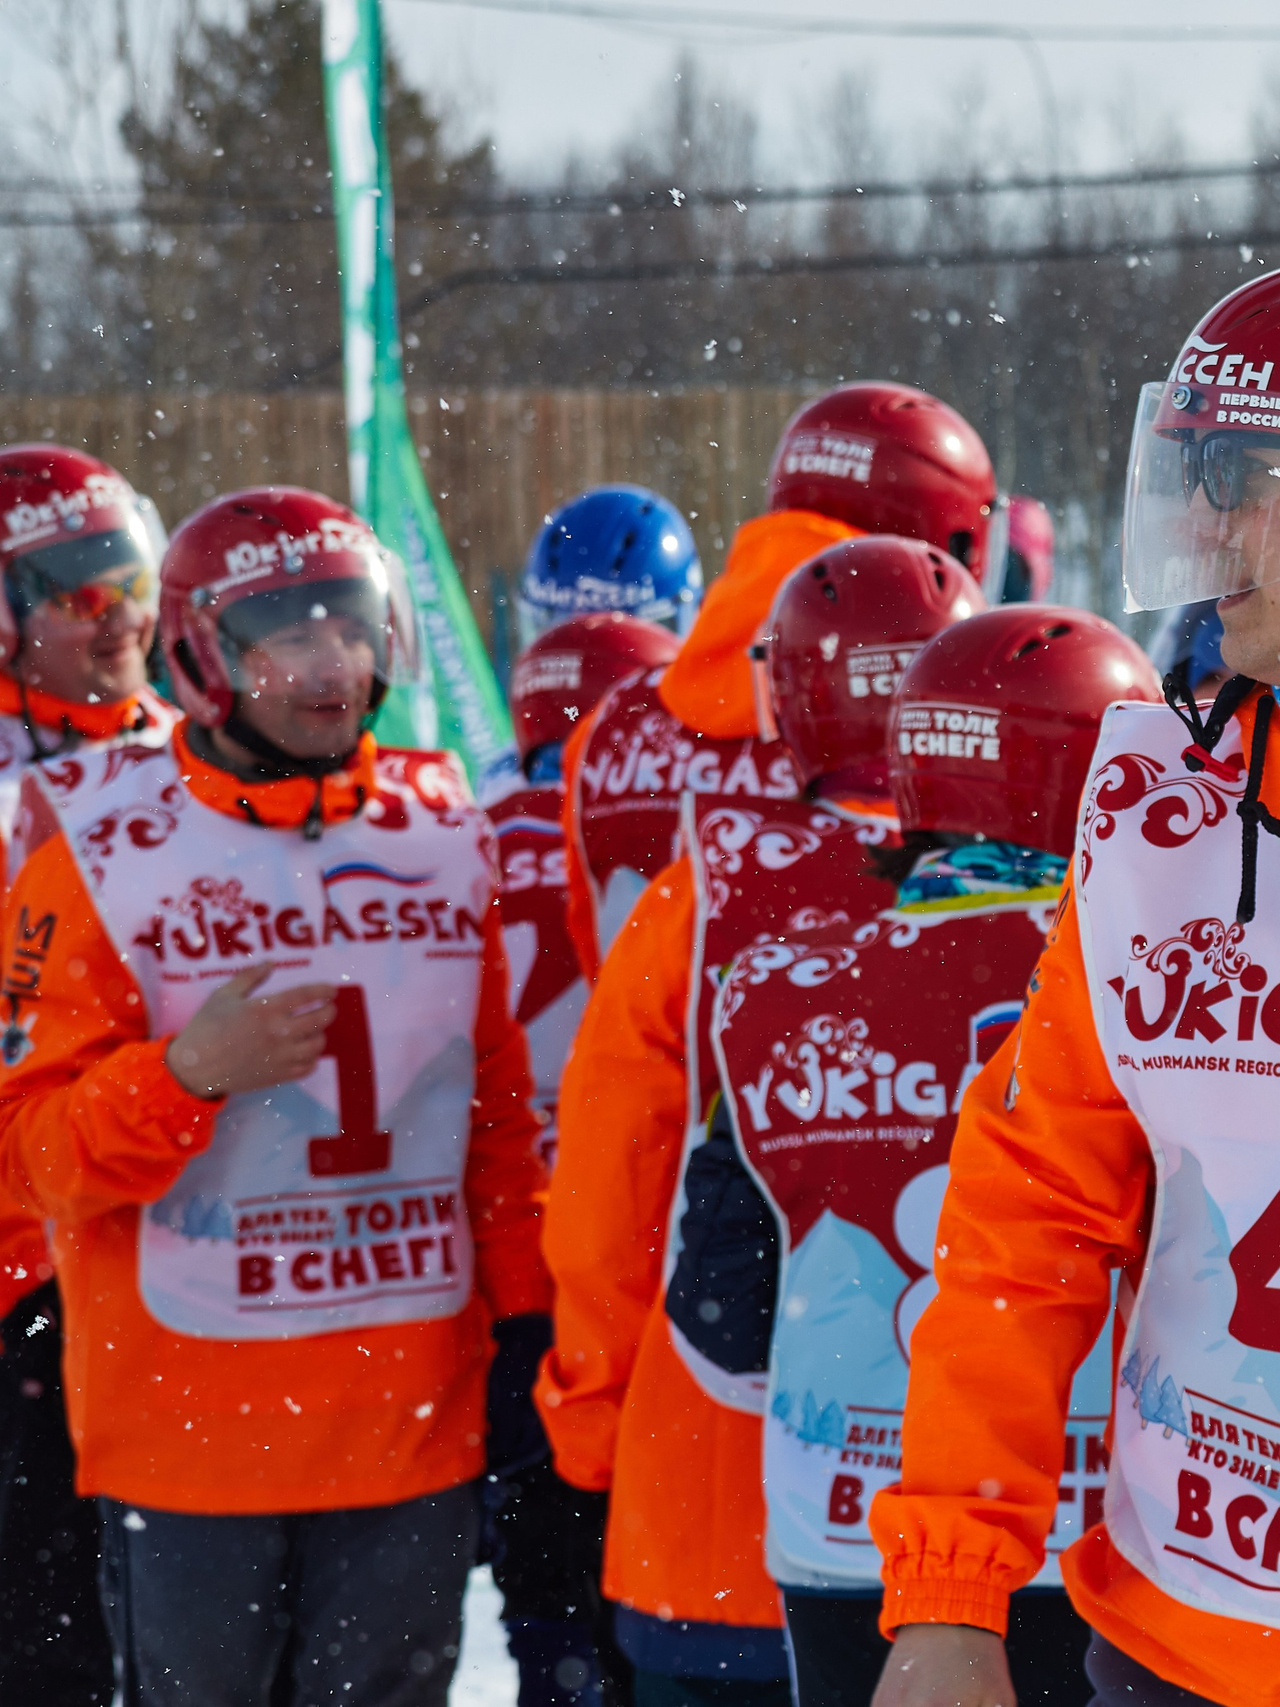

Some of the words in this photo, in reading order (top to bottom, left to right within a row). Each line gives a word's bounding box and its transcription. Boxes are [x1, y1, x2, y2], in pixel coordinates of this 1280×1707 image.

[1216, 411, 1228, 423] В
[934, 711, 1000, 737] ТОЛК
[913, 732, 1001, 761] СНЕГЕ
[1142, 1055, 1231, 1072] MURMANSK
[307, 984, 393, 1179] 1
[237, 1253, 276, 1297] В
[1190, 1411, 1240, 1445] ДЛЯ
[1187, 1439, 1228, 1468] КТО
[828, 1472, 865, 1526] В
[1174, 1468, 1214, 1539] В
